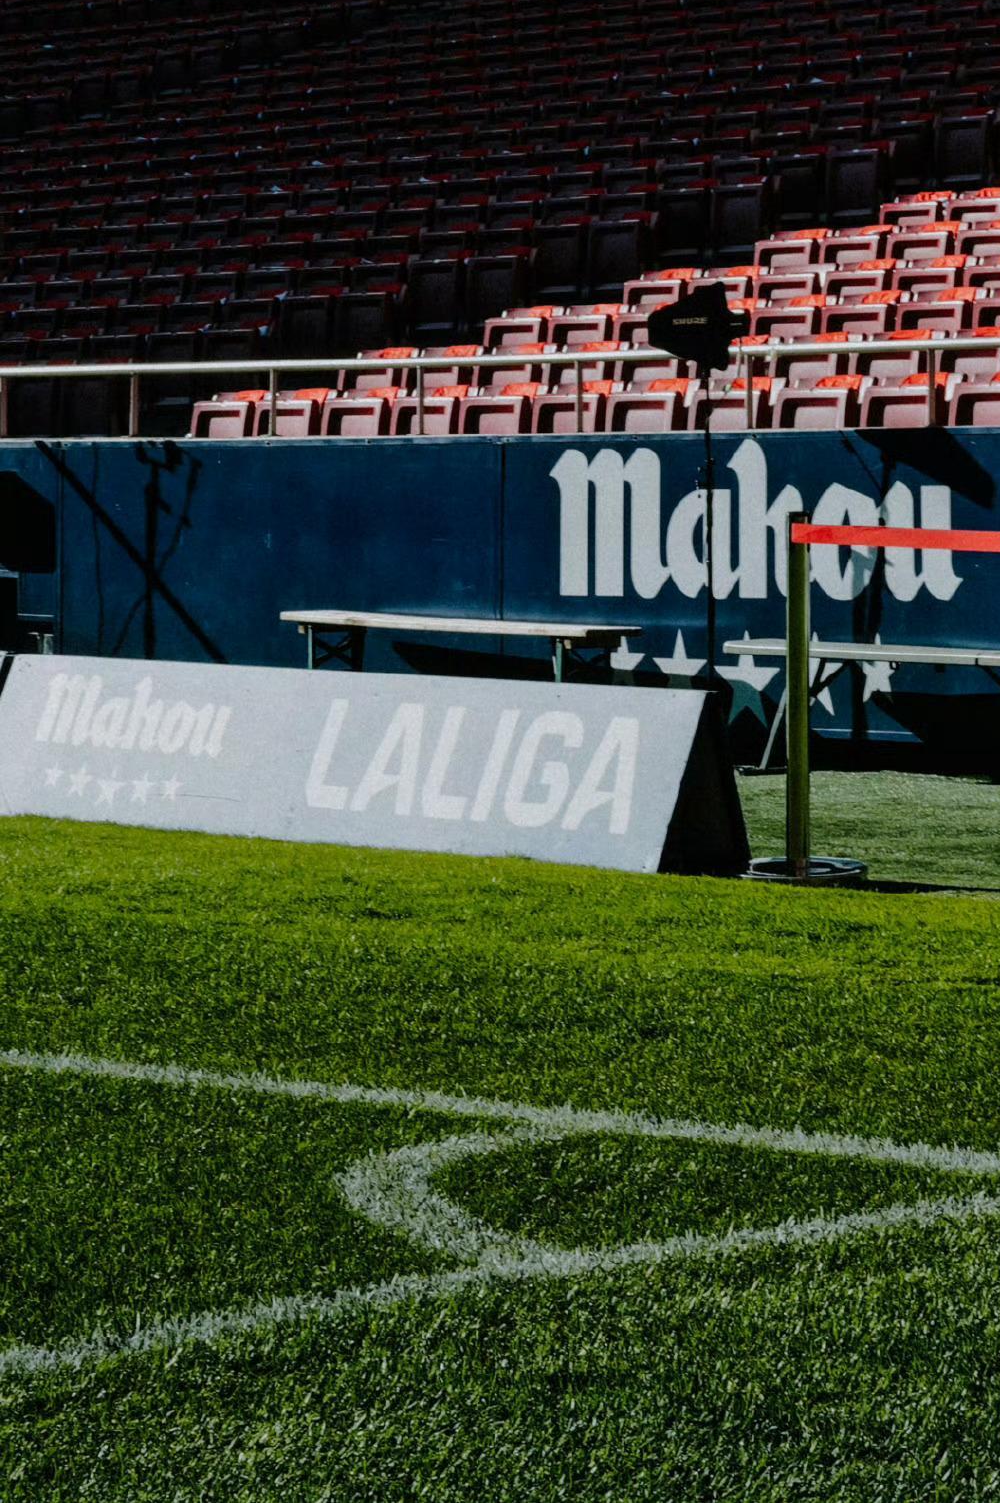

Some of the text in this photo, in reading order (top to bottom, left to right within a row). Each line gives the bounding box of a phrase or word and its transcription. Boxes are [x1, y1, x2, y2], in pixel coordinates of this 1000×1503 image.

[549, 438, 964, 602] Mahou
[35, 672, 231, 760] Mahou
[305, 698, 642, 835] LALIGA
